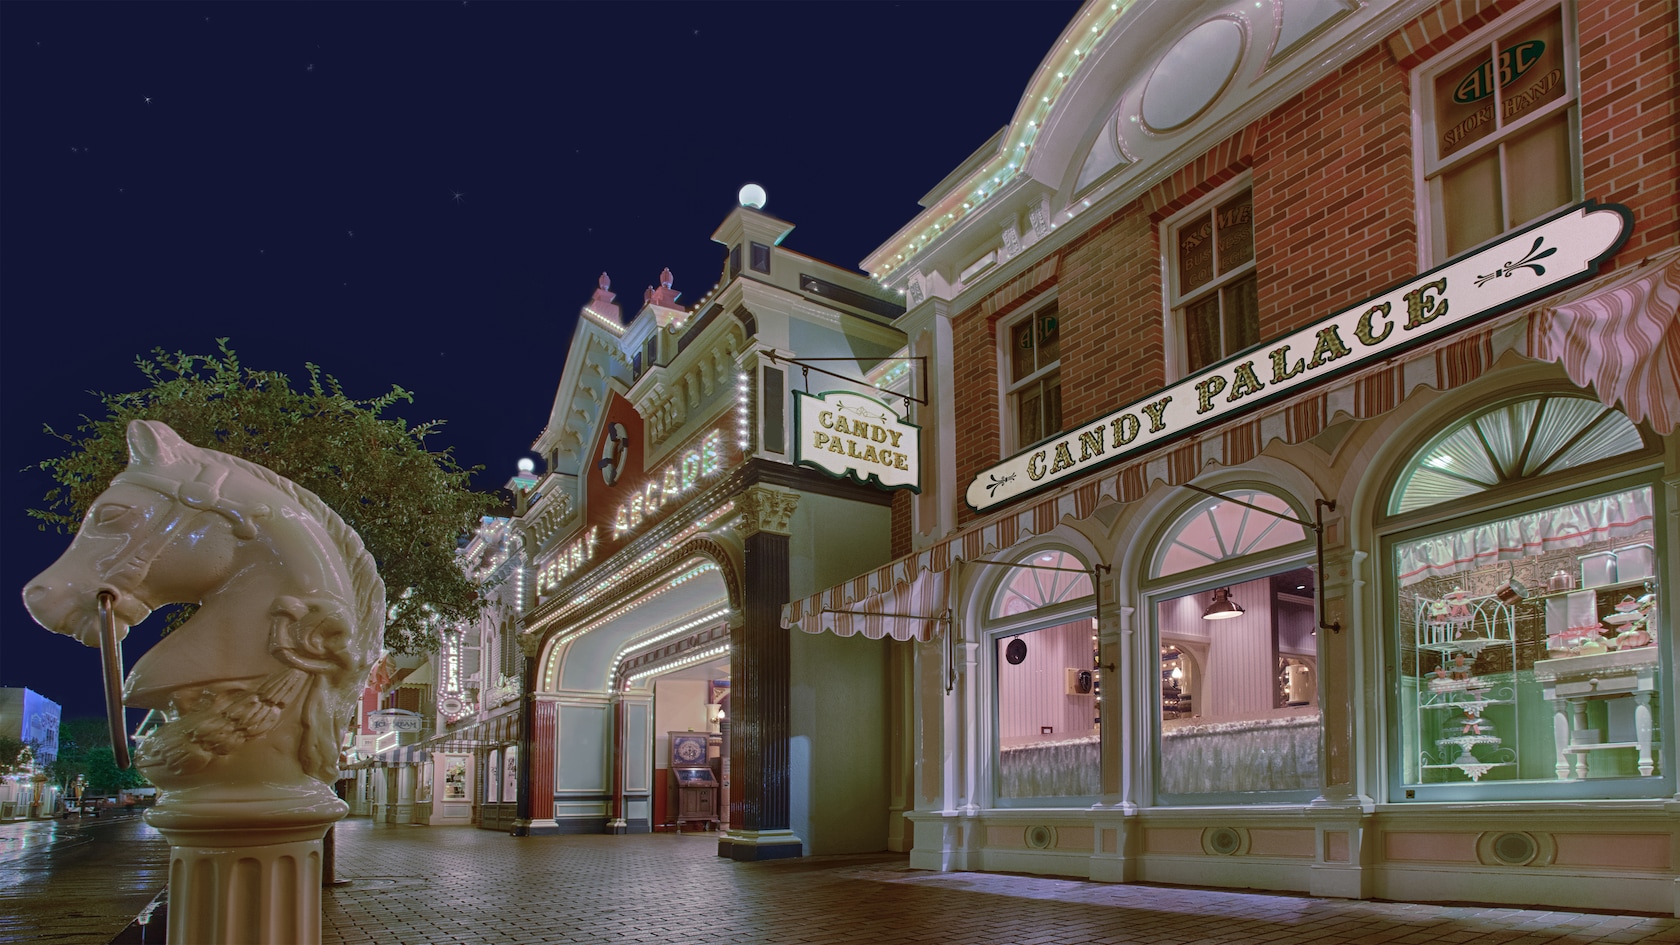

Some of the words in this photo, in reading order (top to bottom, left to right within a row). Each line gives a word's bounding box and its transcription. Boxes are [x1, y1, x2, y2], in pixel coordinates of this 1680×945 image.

[1457, 43, 1535, 100] ABC
[1443, 103, 1496, 147] SHORT
[1502, 68, 1562, 119] HAND
[1185, 226, 1251, 271] BUSNESS
[1026, 396, 1172, 482] CANDY
[1195, 277, 1448, 414] PALACE
[813, 430, 909, 471] PALACE
[818, 410, 903, 448] CANDY
[536, 525, 597, 596] PENNY
[613, 428, 720, 541] ARCADE
[447, 656, 459, 692] CREAM
